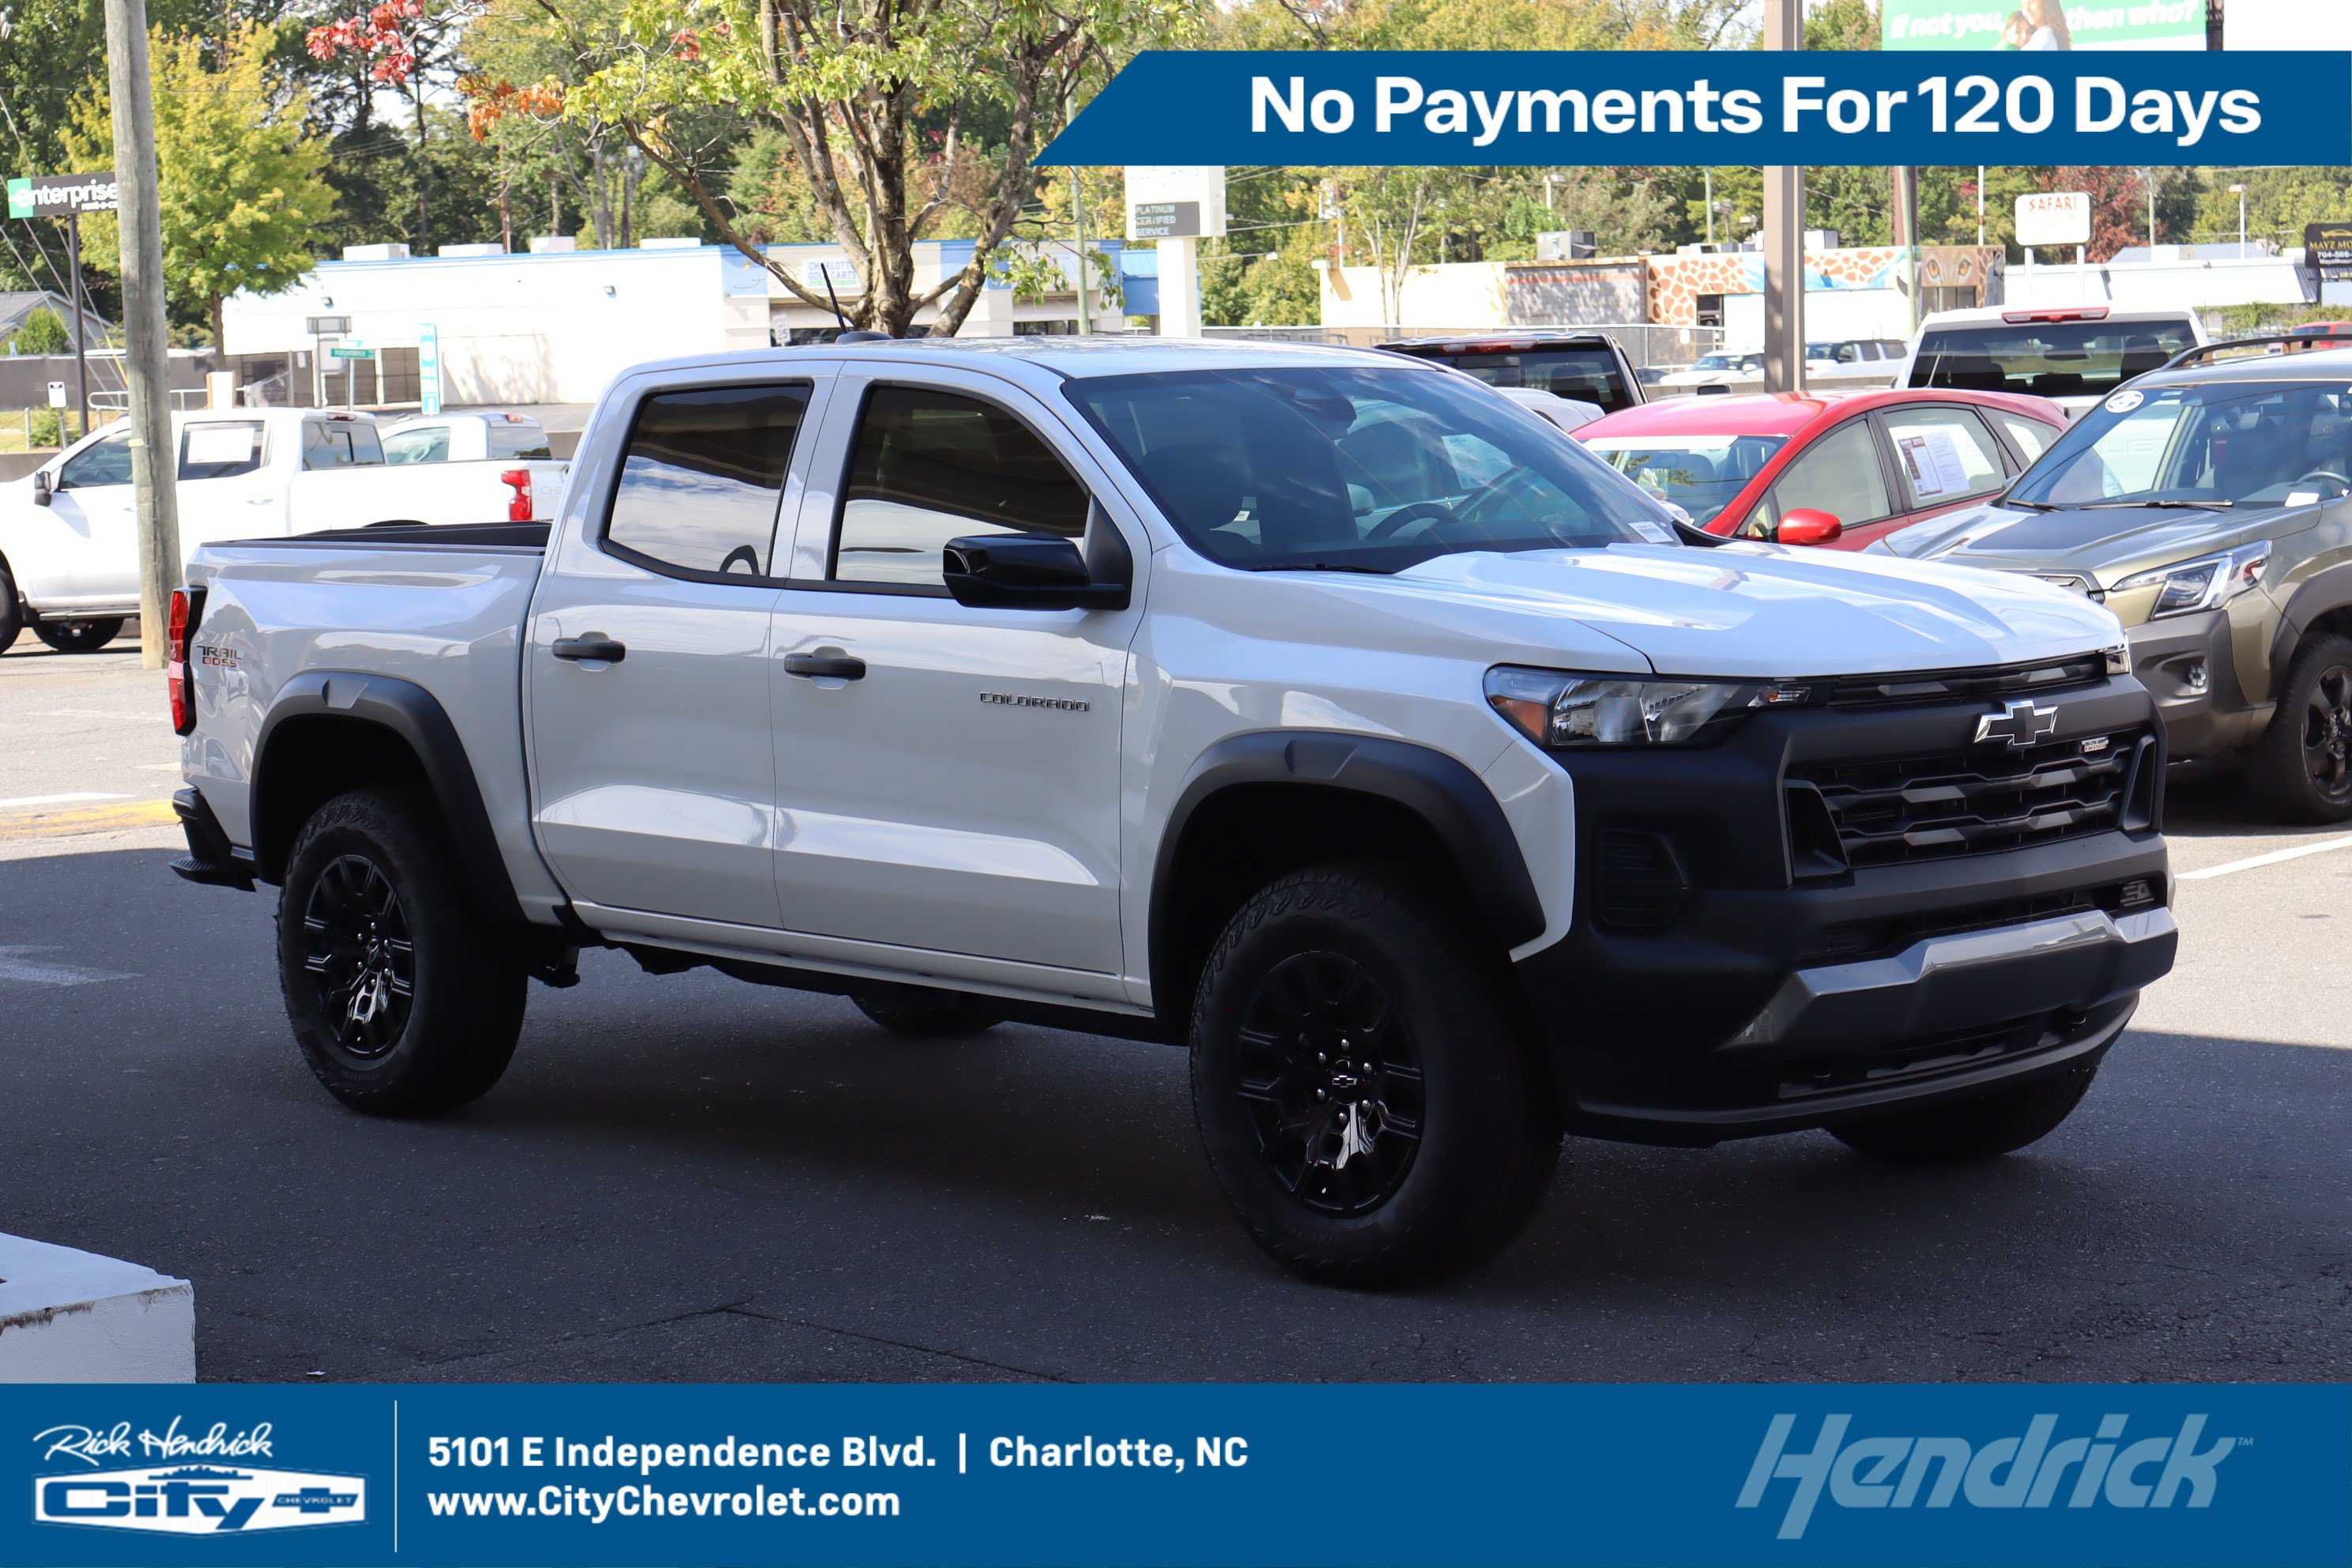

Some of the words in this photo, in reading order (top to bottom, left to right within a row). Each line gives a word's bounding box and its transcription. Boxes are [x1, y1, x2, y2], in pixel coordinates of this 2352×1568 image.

[1890, 13, 1909, 38] If
[1909, 13, 1950, 37] not
[2064, 6, 2124, 31] then
[2128, 0, 2199, 27] who?
[13, 179, 118, 209] enterprise
[1136, 204, 1176, 215] PLATINUM
[2029, 195, 2076, 213] SAFARI
[1136, 215, 1177, 225] CERTIFIED
[1136, 226, 1170, 236] SERVICE
[2309, 240, 2335, 251] MAYZ
[196, 645, 242, 660] TRAIL
[202, 656, 237, 668] BOSS
[980, 691, 1090, 712] COLORADO
